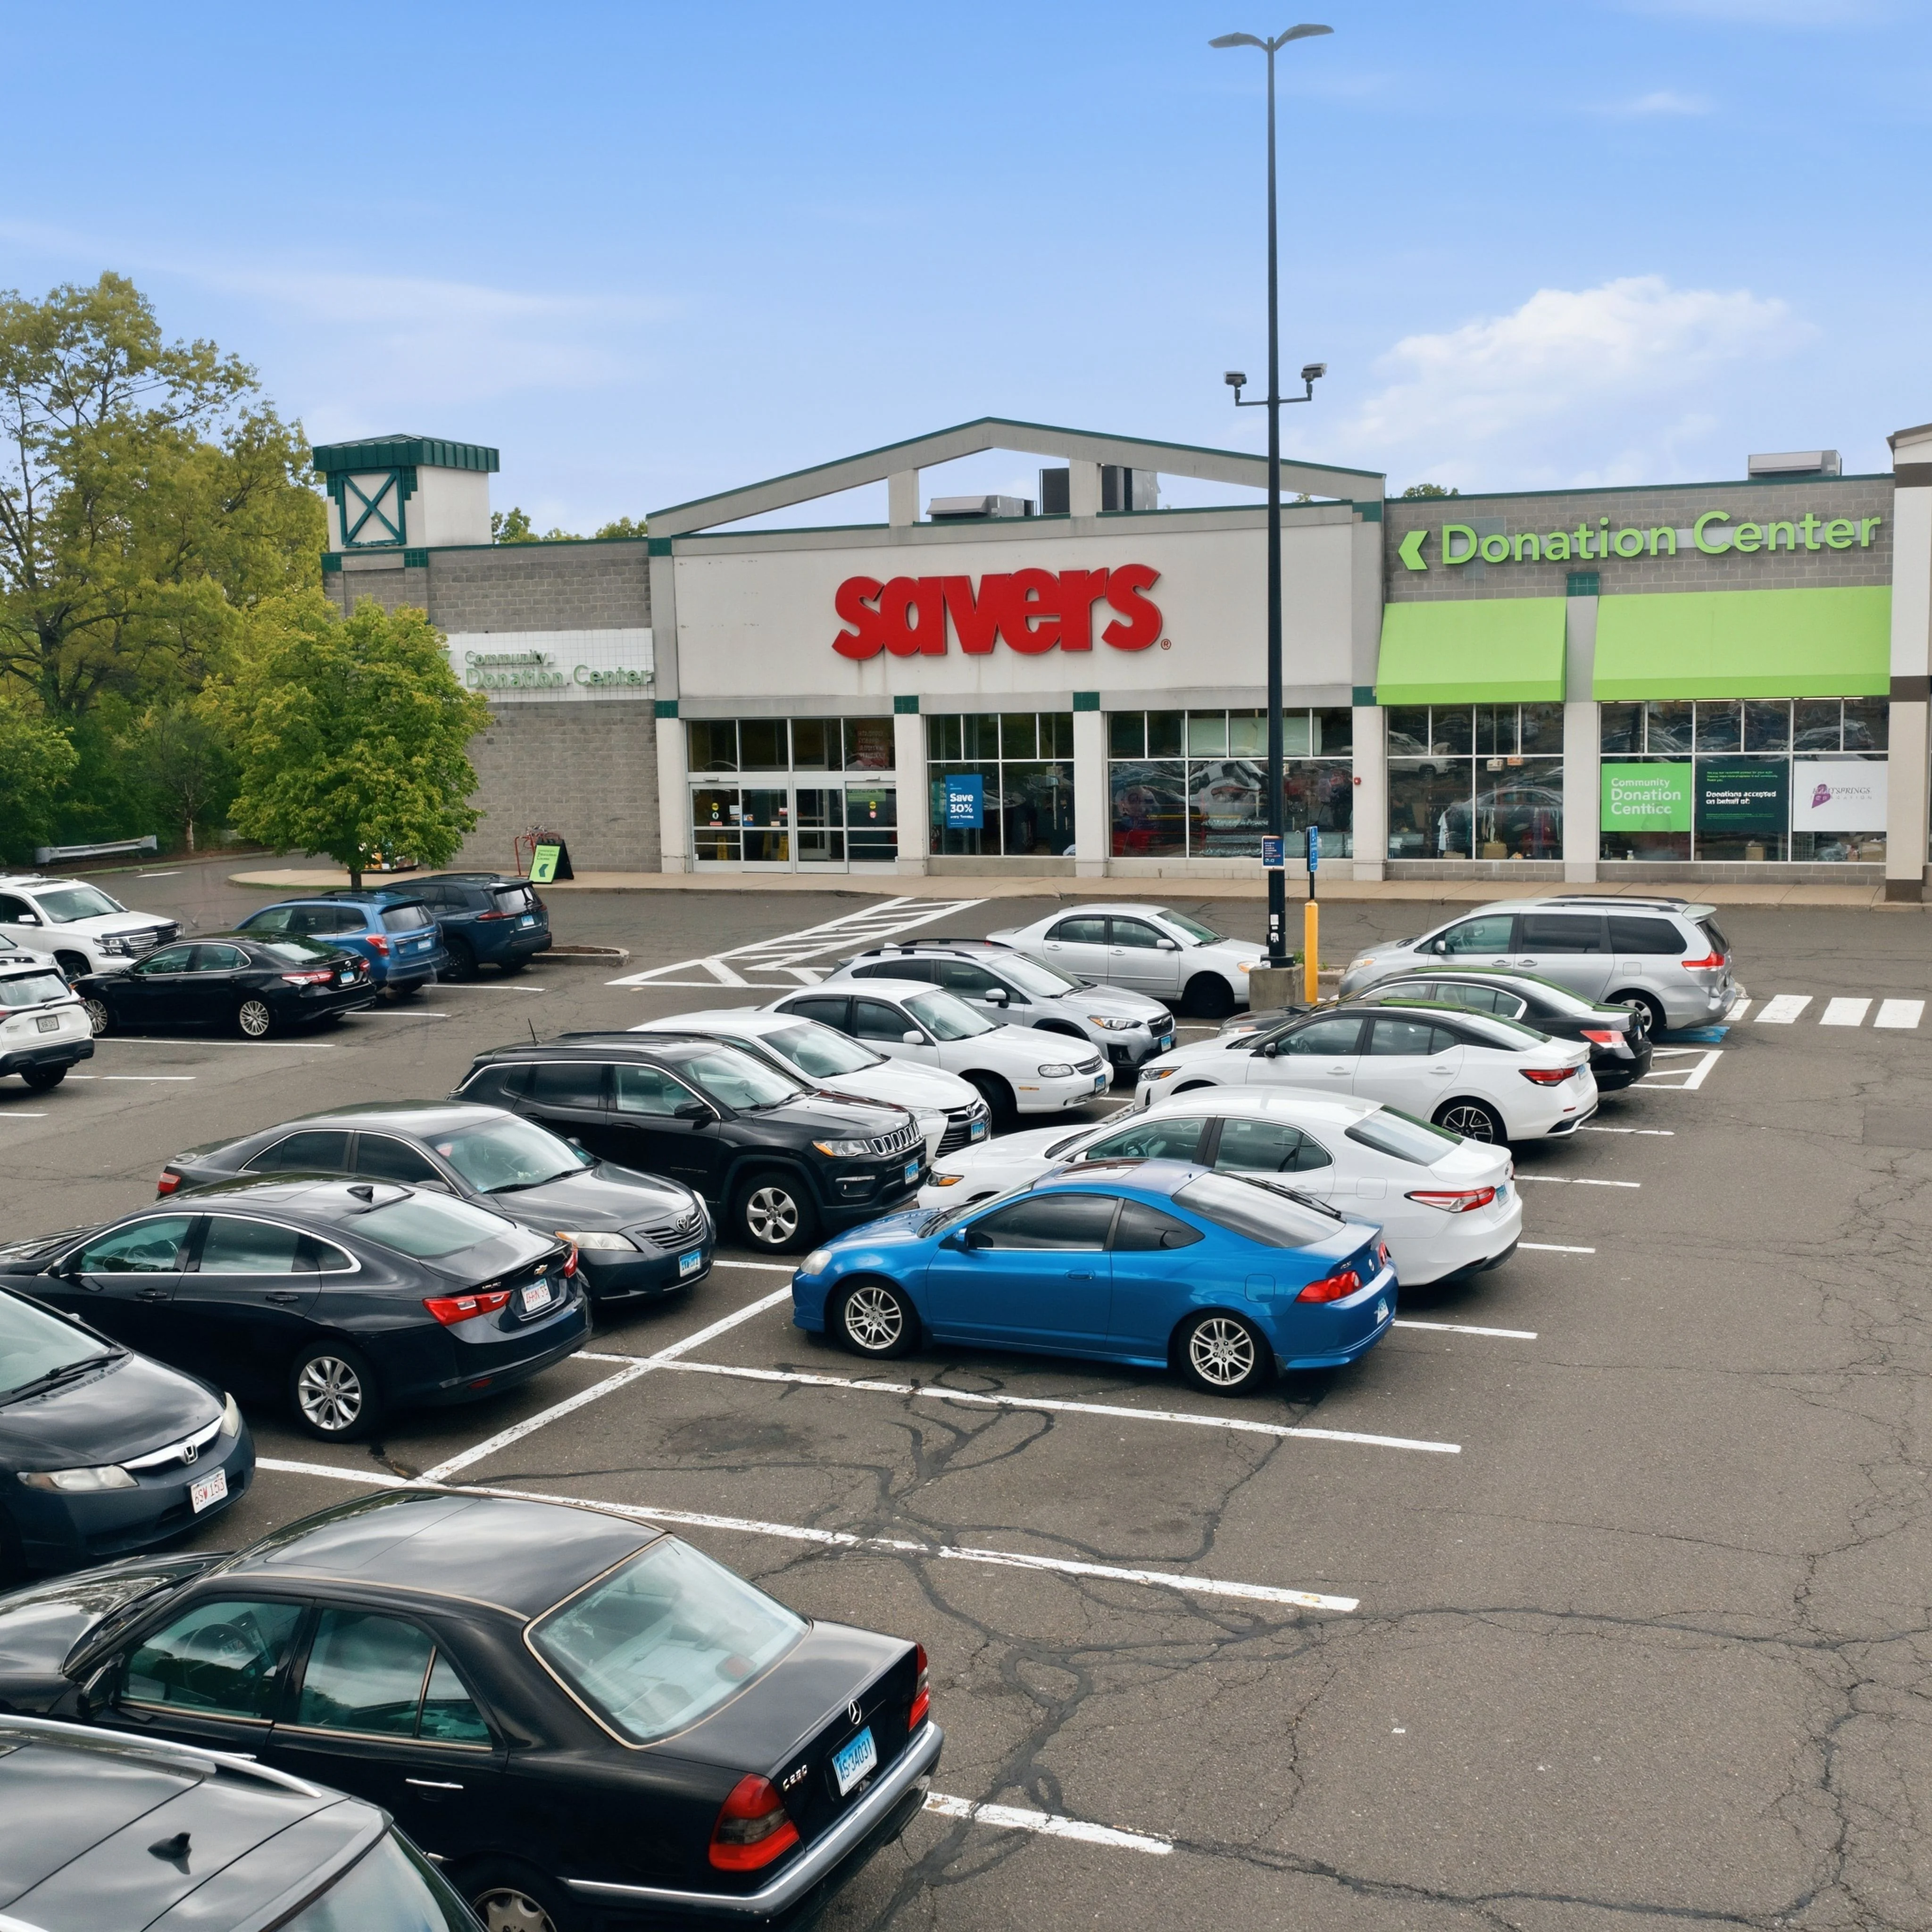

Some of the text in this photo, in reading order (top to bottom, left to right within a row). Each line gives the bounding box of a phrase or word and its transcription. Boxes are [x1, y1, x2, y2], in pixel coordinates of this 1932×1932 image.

[1442, 510, 1882, 564] Donation Center
[832, 564, 1163, 660] savers
[465, 650, 547, 666] Community
[465, 664, 651, 688] Donation Center
[950, 793, 974, 802] Save
[1611, 788, 1681, 801] Donation
[950, 804, 973, 813] 30%
